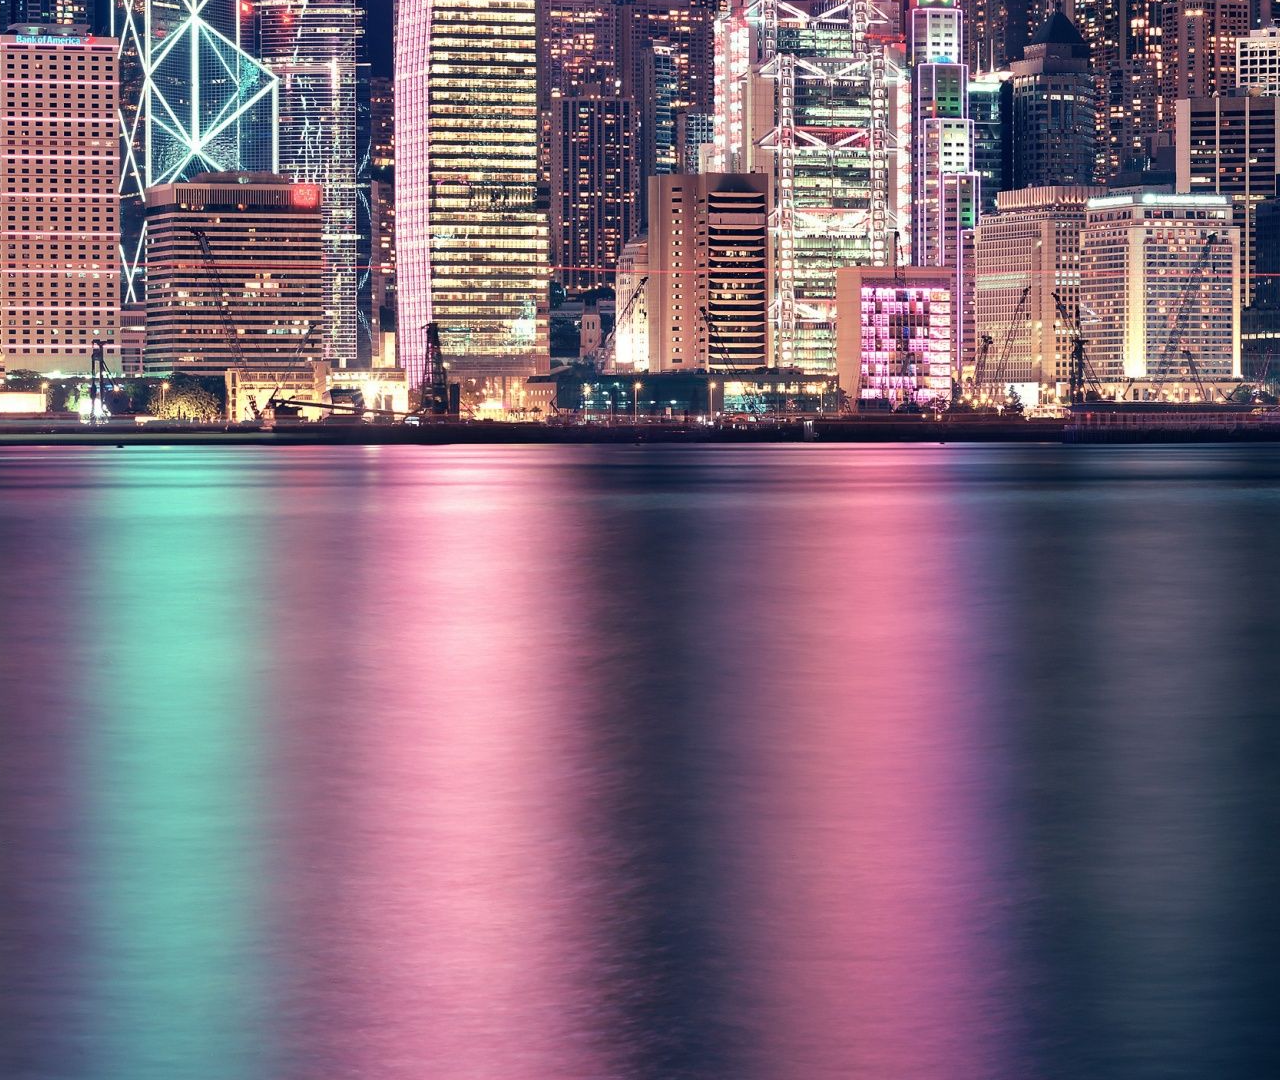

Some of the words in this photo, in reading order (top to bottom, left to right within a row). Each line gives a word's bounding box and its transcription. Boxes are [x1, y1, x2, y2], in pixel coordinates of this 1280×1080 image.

[16, 35, 36, 44] Bank
[38, 35, 45, 44] of
[46, 35, 81, 45] America
